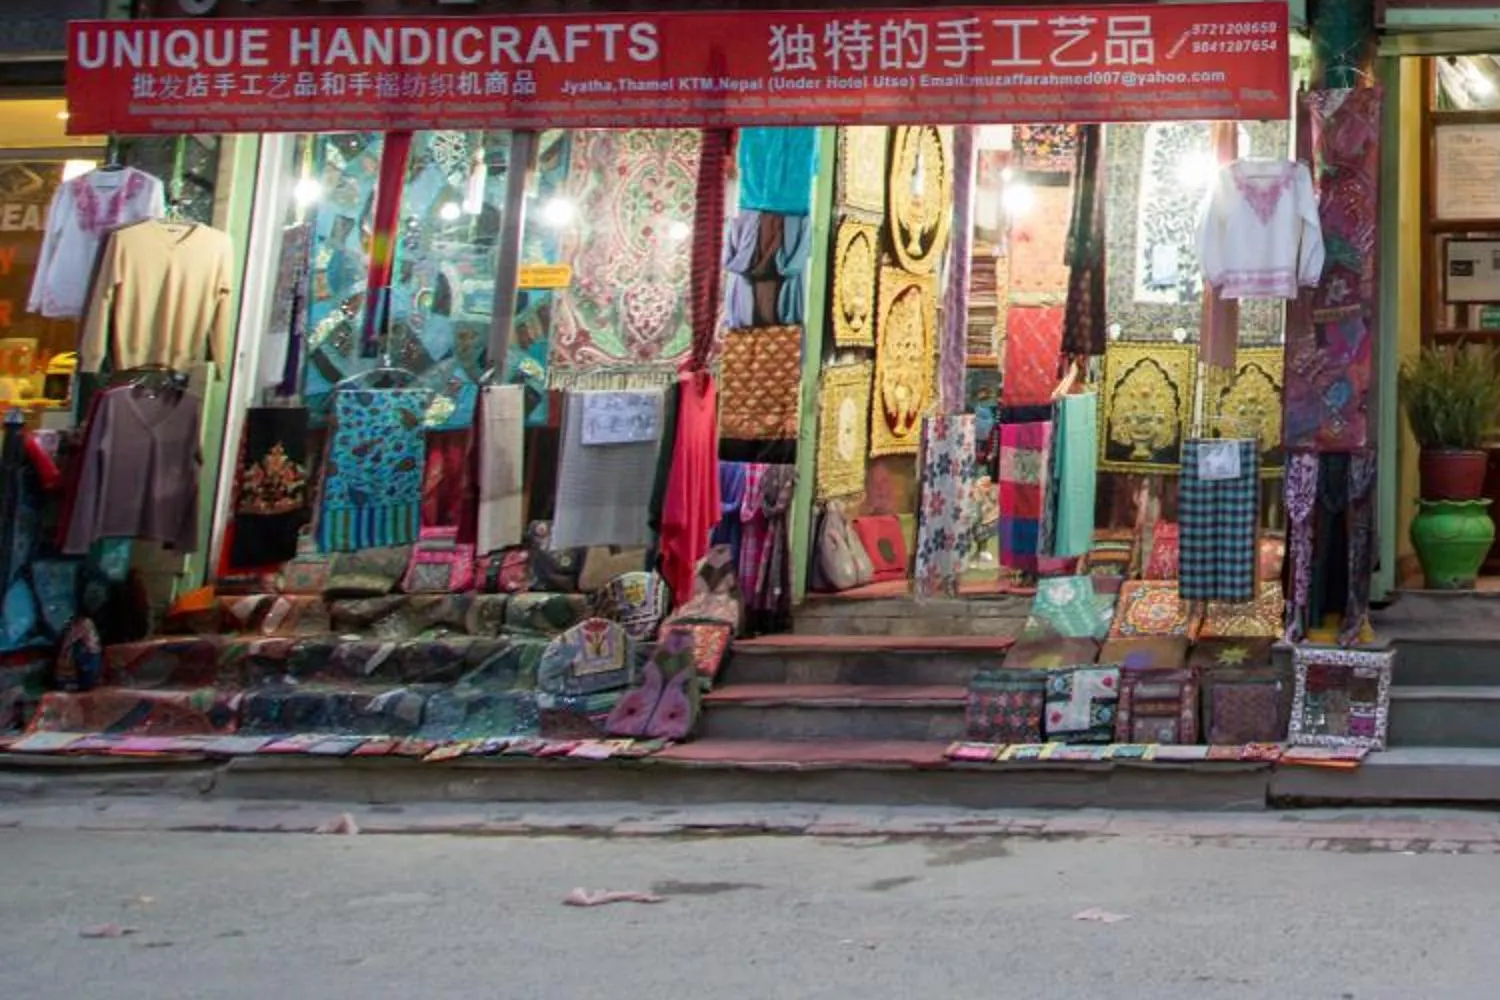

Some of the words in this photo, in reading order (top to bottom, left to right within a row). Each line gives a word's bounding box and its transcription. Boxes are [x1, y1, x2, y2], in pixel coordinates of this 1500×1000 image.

[76, 26, 269, 69] UNIQUE
[288, 22, 660, 66] HANDICRAFTS
[769, 14, 1156, 72] 独特的手工艺品
